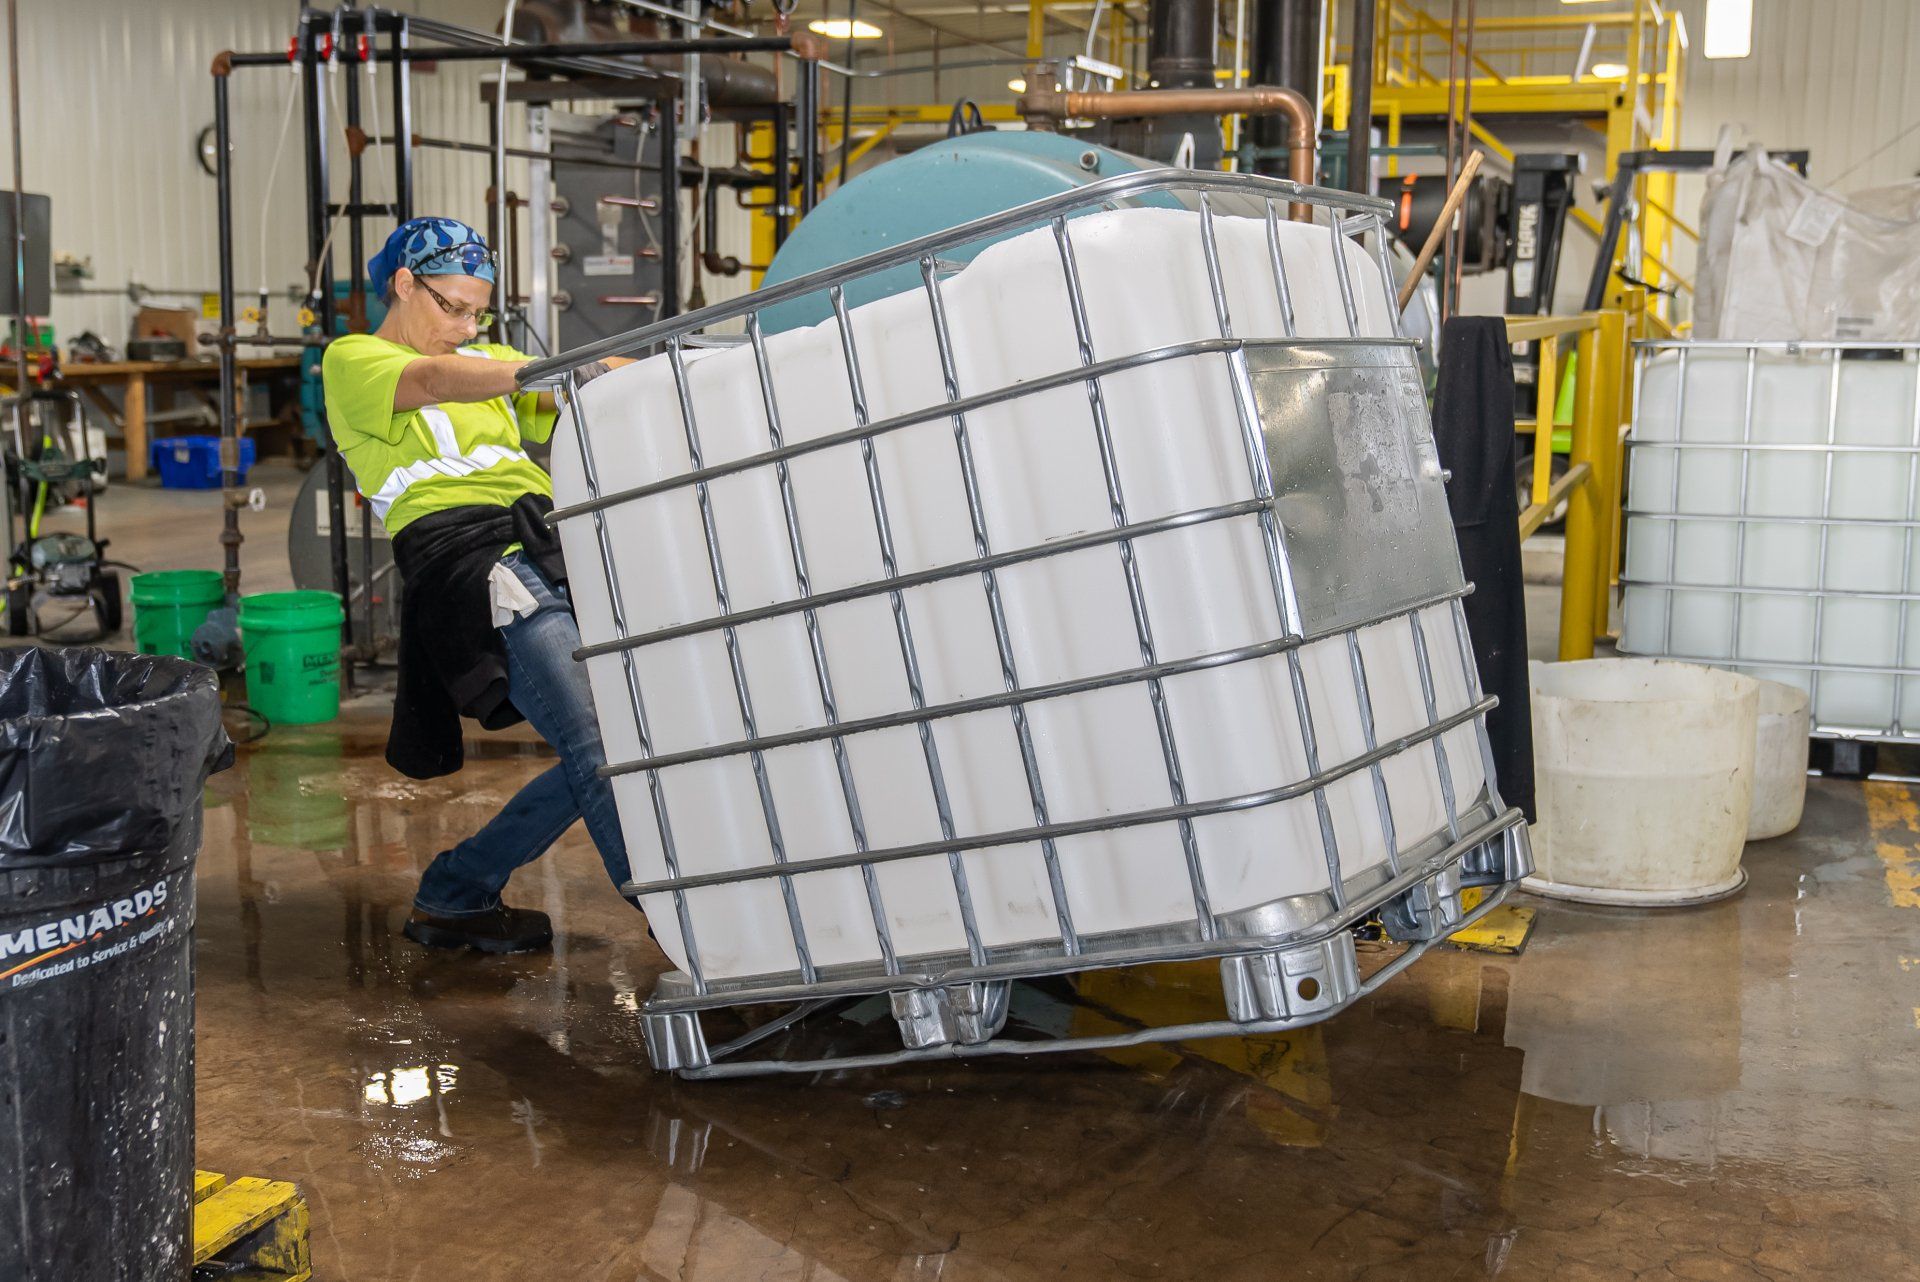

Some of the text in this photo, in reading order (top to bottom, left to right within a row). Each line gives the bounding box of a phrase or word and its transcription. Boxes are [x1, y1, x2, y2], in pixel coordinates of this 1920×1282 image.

[1516, 204, 1538, 258] CLARK
[0, 881, 167, 960] MENARDS
[12, 959, 75, 987] Dedicated
[76, 955, 91, 970] to
[91, 940, 129, 965] Service
[129, 935, 138, 949] &
